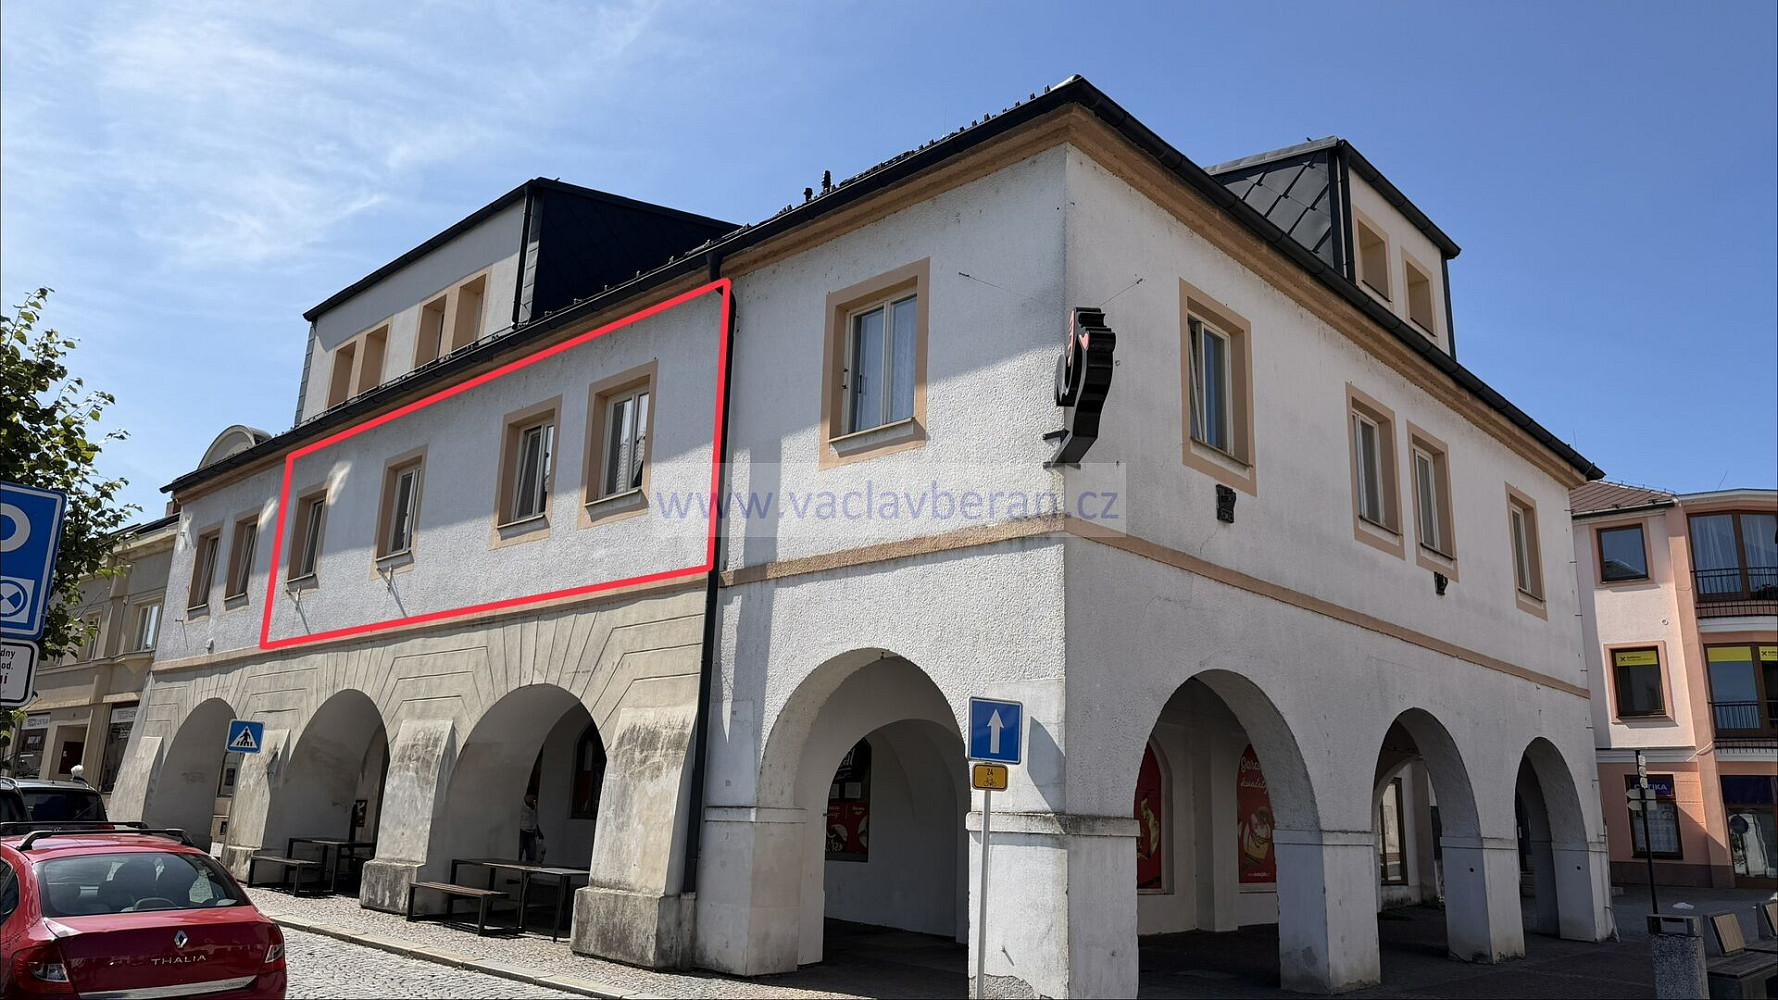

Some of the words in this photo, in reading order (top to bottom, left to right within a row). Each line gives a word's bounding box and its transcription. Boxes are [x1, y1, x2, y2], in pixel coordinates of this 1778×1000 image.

[1, 661, 14, 670] od.
[986, 768, 994, 776] 24
[151, 955, 206, 965] THALIA
